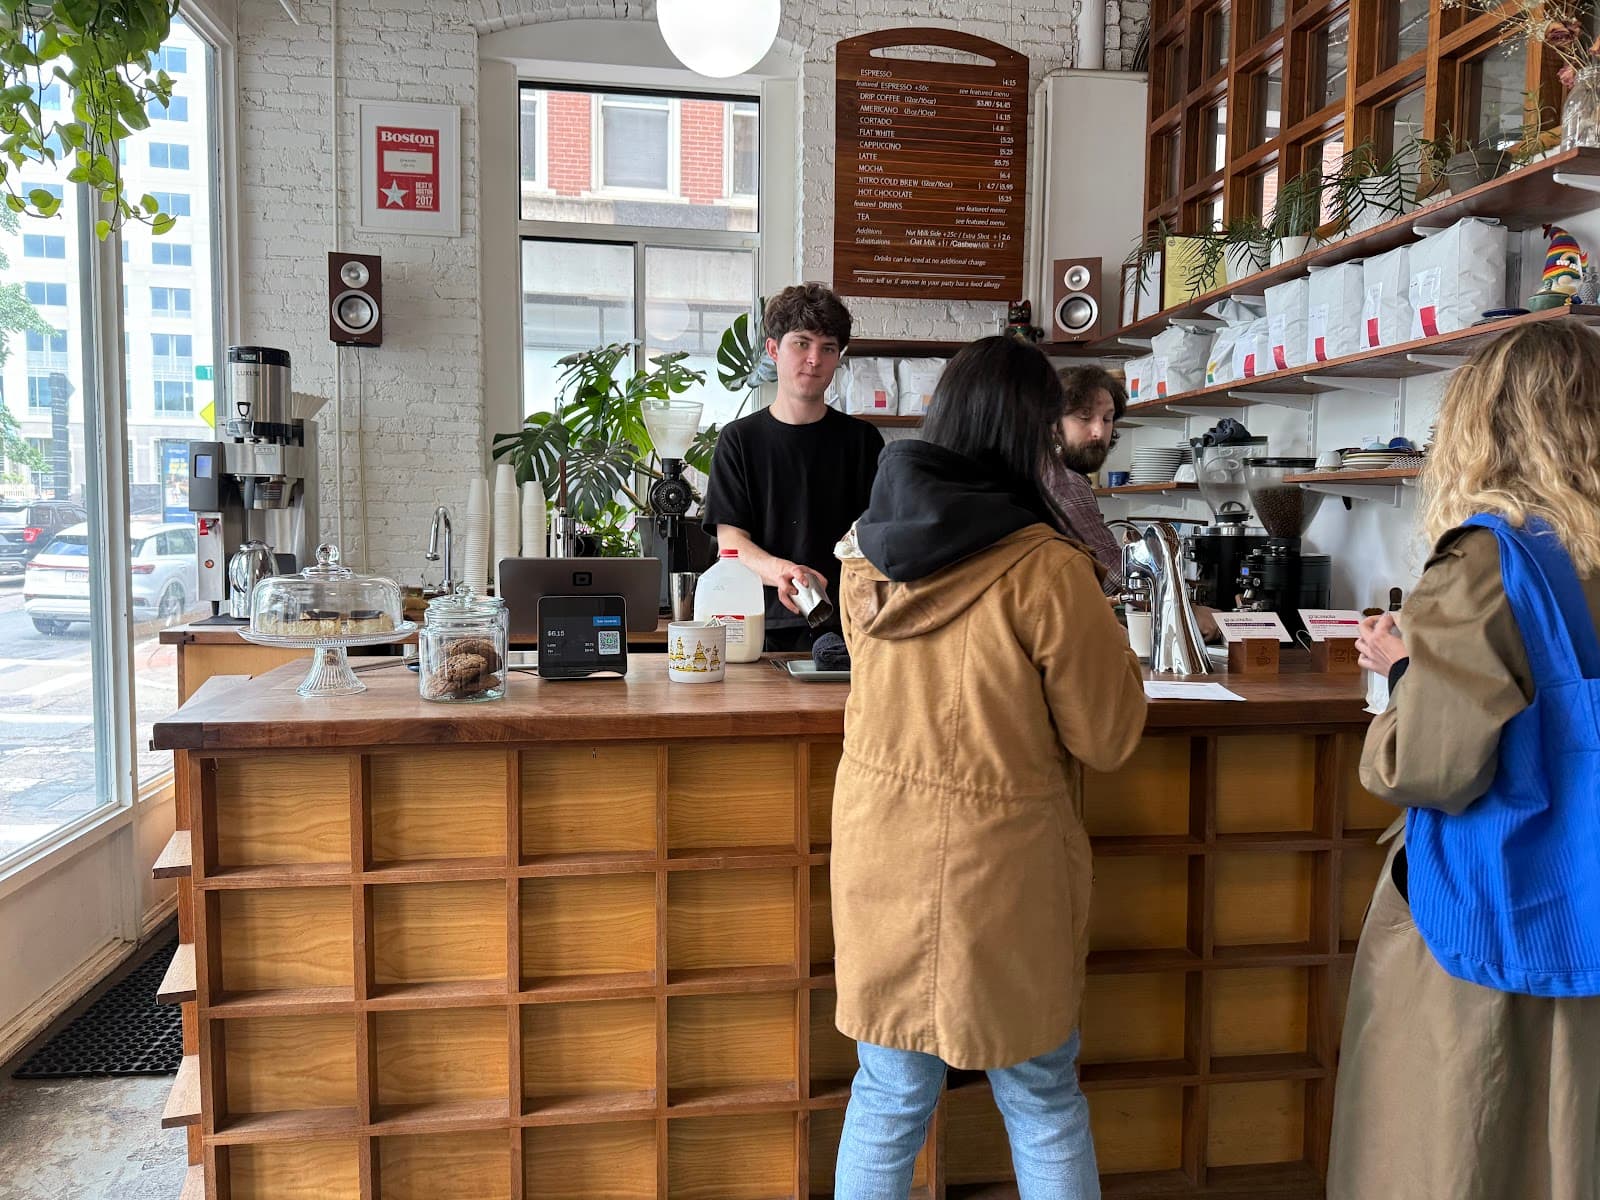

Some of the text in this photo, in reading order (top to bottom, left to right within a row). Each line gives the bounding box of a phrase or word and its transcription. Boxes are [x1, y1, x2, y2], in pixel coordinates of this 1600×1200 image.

[860, 69, 892, 78] ESPRESSO
[880, 82, 912, 90] ESPRESSO
[970, 88, 993, 96] featured
[877, 94, 900, 102] COFFEE
[860, 105, 898, 114] AMERICANO
[860, 116, 892, 125] CORTADO
[381, 131, 434, 145] Boston
[900, 179, 918, 187] BREW
[874, 189, 912, 198] CHOCOLATE
[416, 196, 433, 206] 2017
[952, 240, 978, 248] Cashew
